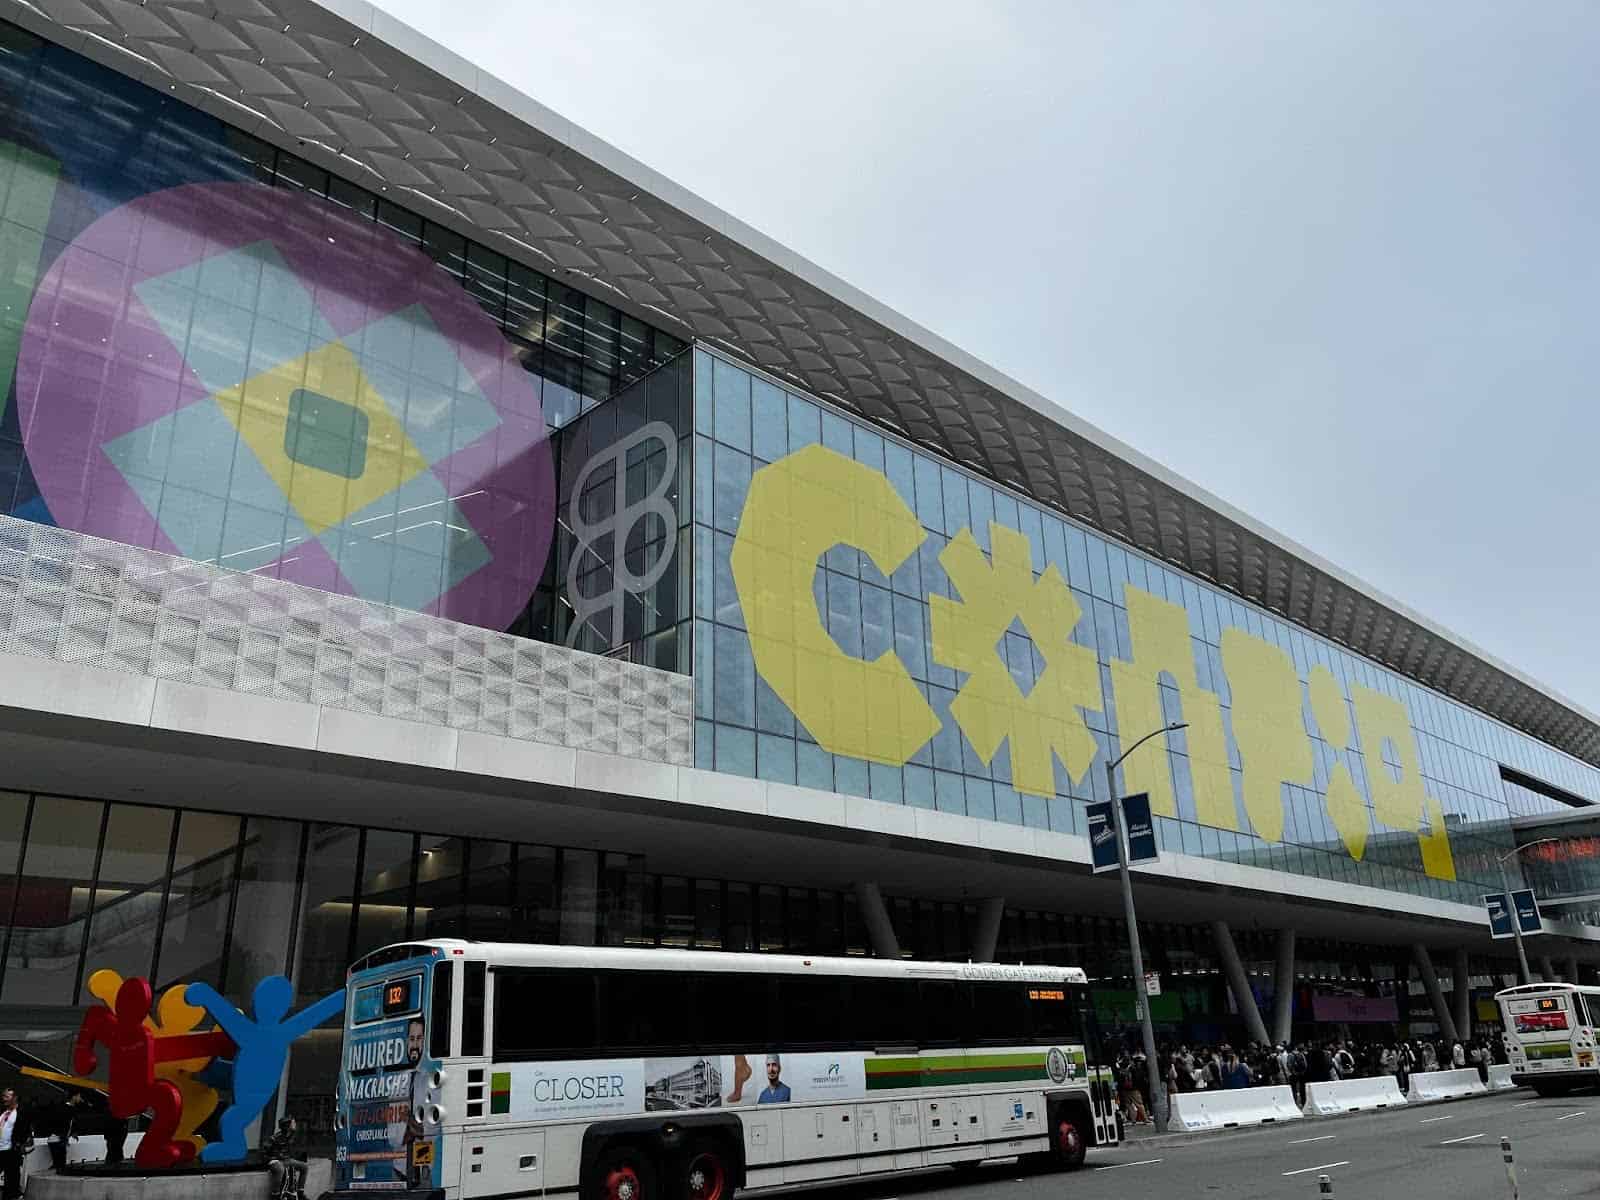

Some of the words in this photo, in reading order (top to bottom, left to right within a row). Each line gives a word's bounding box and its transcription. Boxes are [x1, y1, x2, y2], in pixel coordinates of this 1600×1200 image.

[389, 987, 402, 1004] 132
[348, 1038, 405, 1071] INJURED
[534, 1075, 625, 1102] CLOSER
